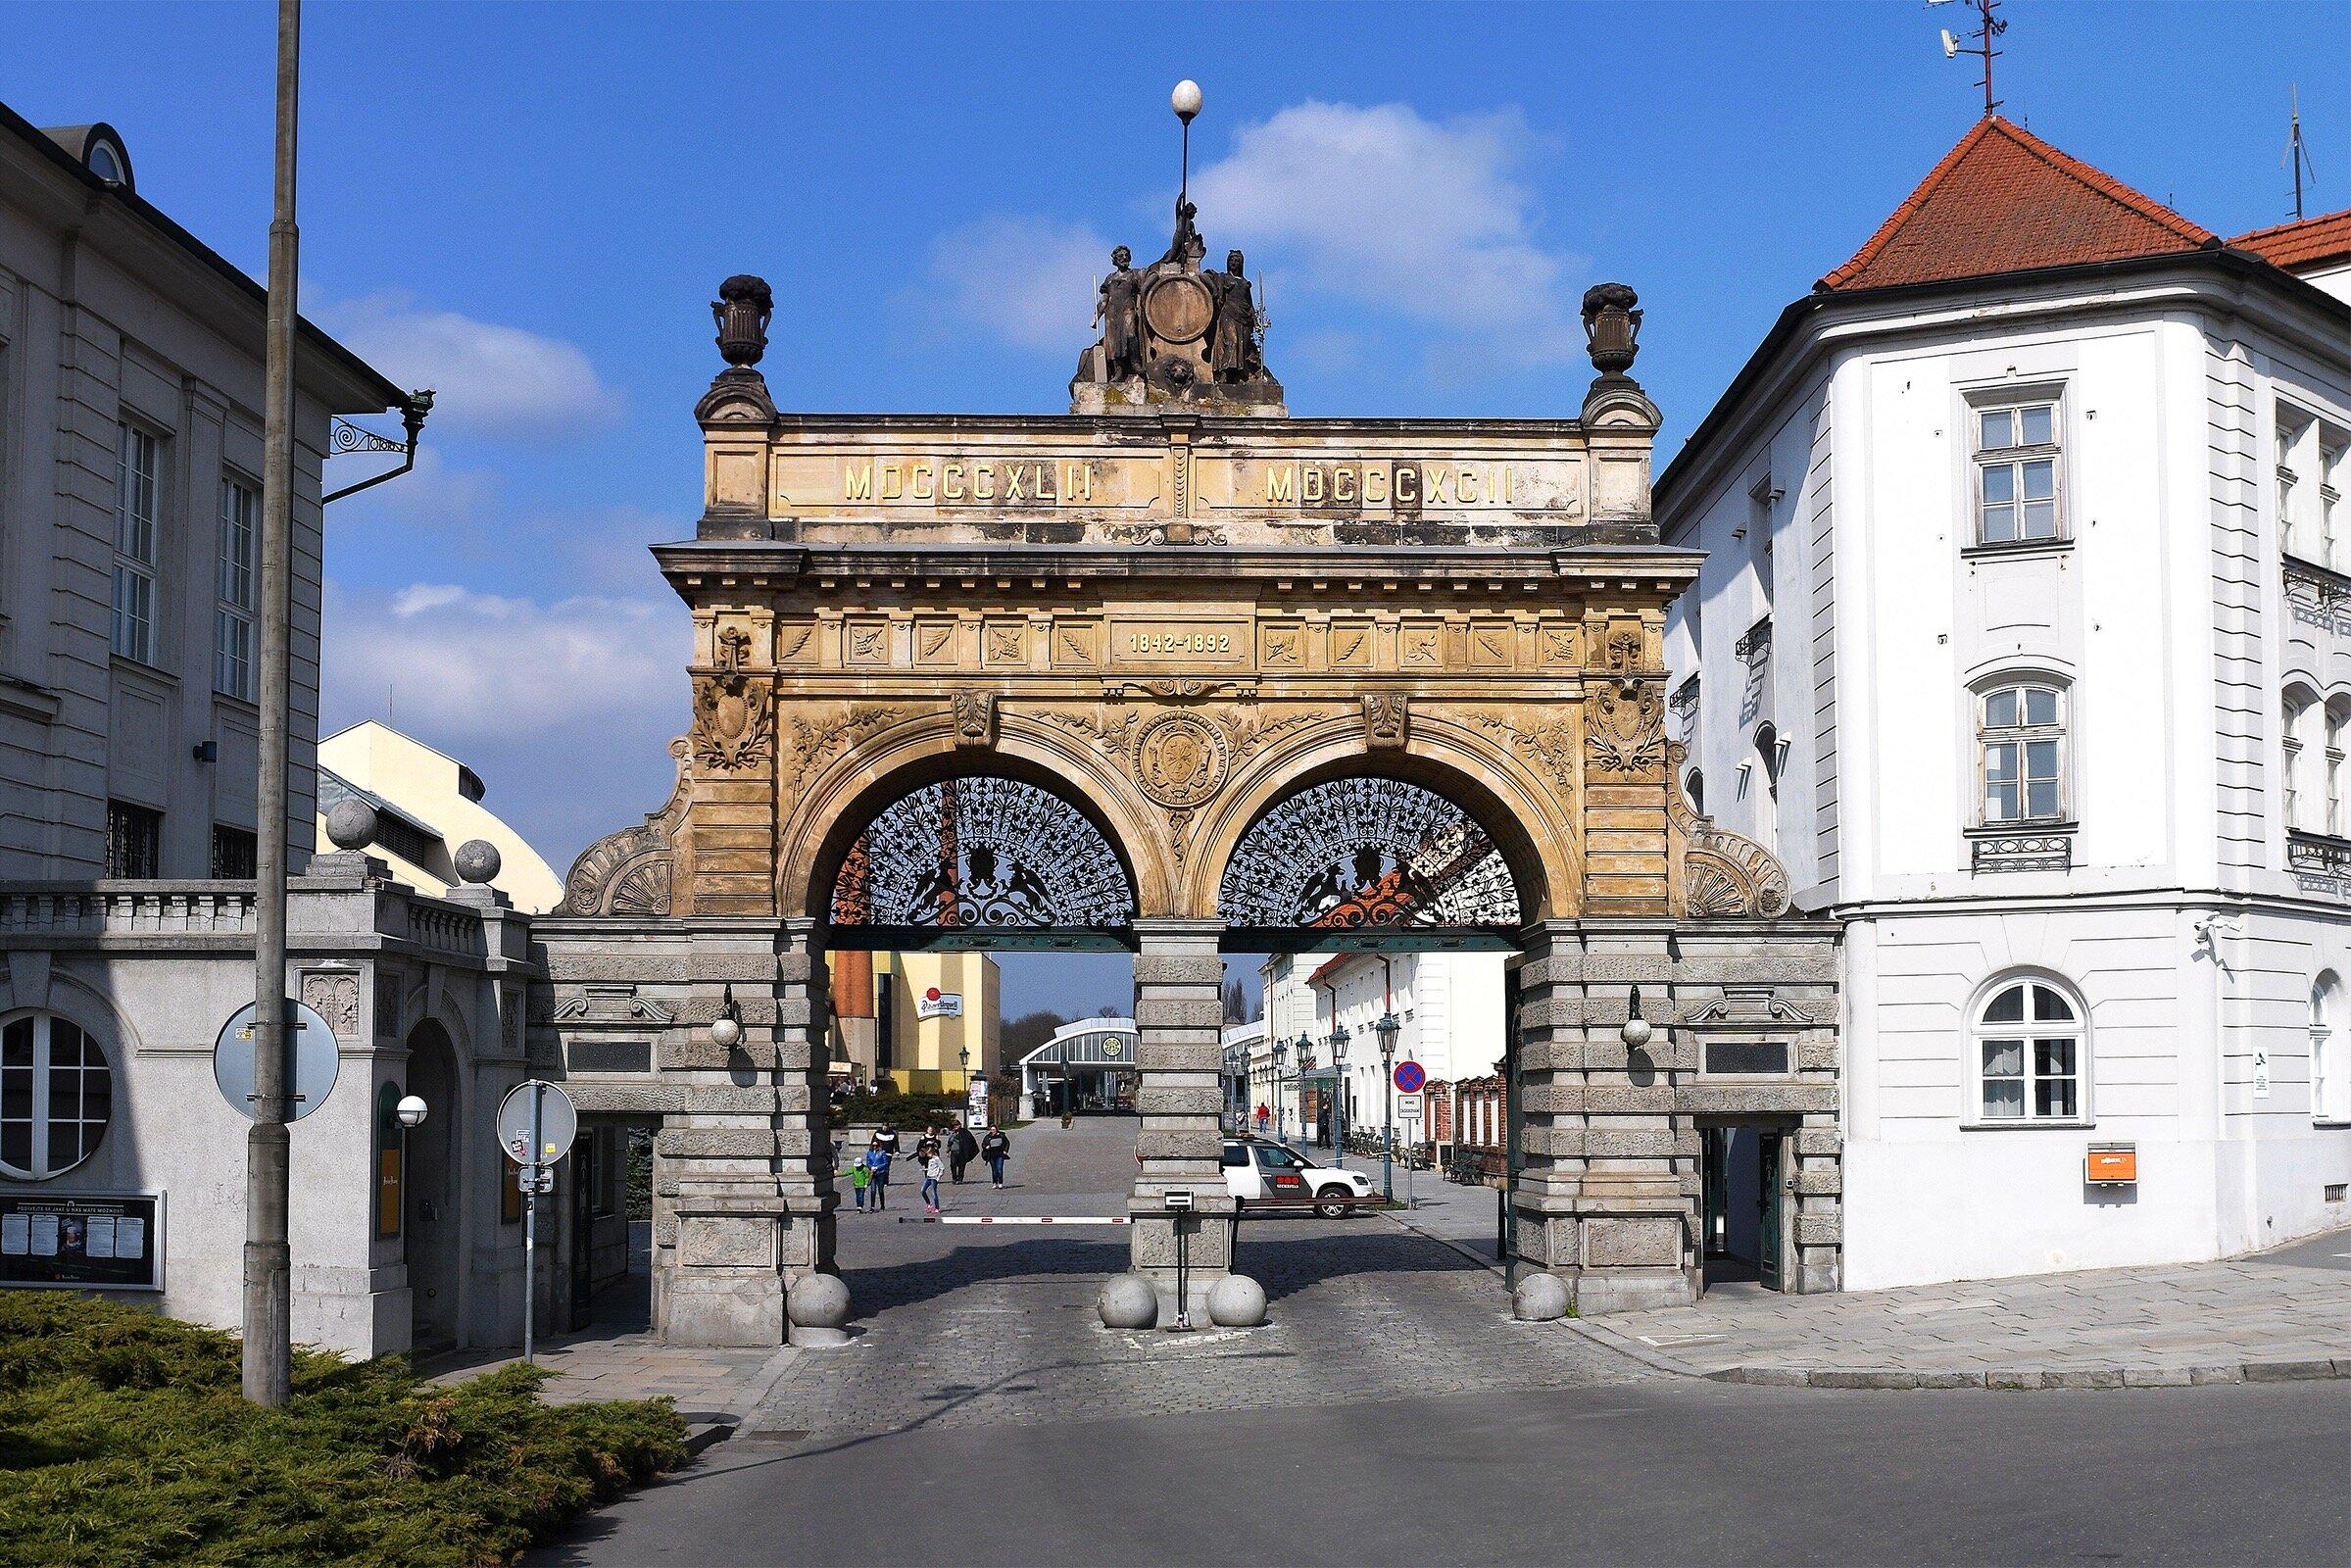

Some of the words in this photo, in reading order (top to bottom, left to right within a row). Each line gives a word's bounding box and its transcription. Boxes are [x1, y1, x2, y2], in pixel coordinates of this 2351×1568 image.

[845, 464, 1092, 501] MDCCCXLII
[1266, 466, 1512, 504] MDCCCXCII
[1130, 633, 1230, 653] 1842-1892
